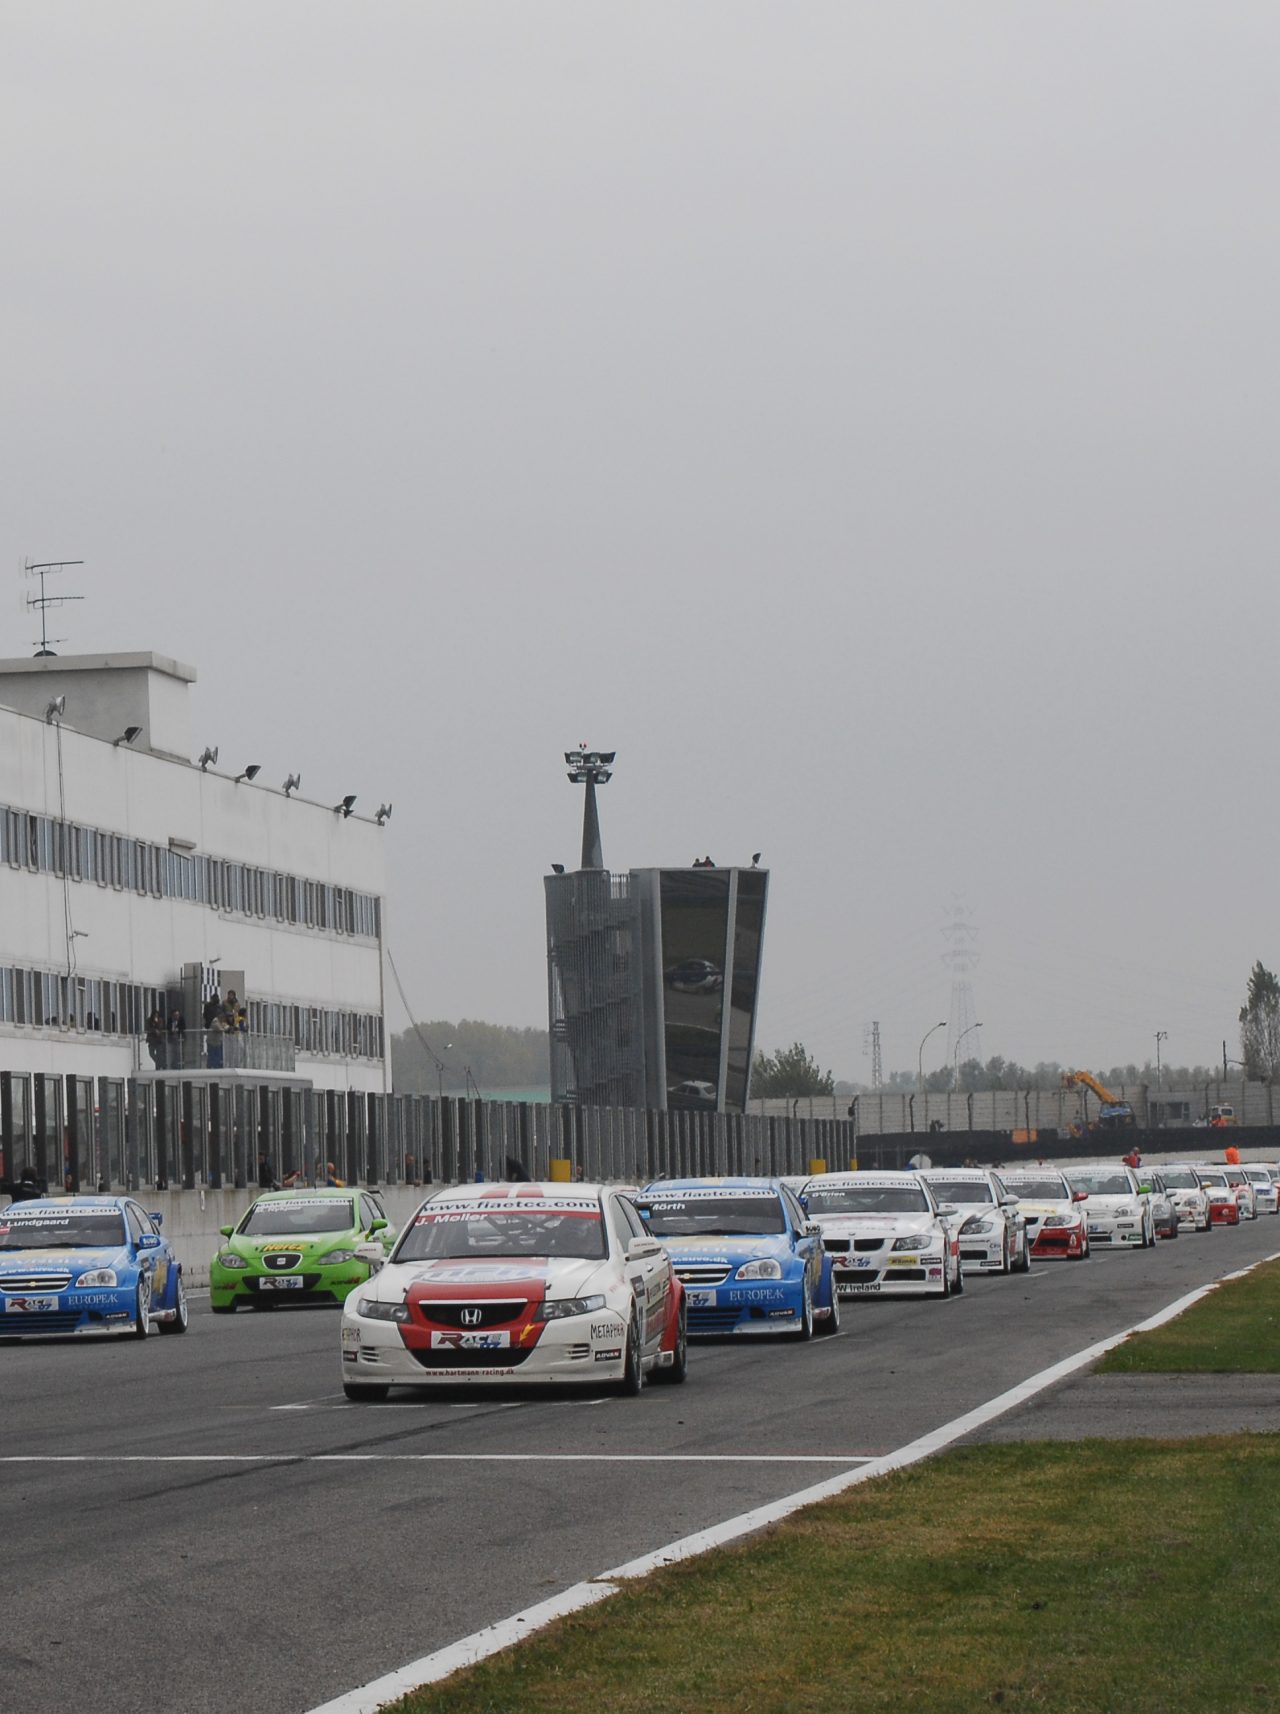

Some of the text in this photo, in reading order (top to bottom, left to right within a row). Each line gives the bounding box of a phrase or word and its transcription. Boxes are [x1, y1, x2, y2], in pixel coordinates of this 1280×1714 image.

[808, 1181, 918, 1189] www.fiaetcc.com
[639, 1190, 776, 1200] www.fiaetcc.com
[422, 1200, 597, 1212] www.fiaetcc.com
[1, 1207, 121, 1217] www.fiaetcc.com
[6, 1218, 70, 1228] Lundgaard
[414, 1216, 428, 1226] J.
[849, 1282, 881, 1291] Ireland
[590, 1322, 625, 1340] METAPHOR
[437, 1332, 502, 1349] RACE
[425, 1368, 515, 1377] www.hartmann-racing.dk
